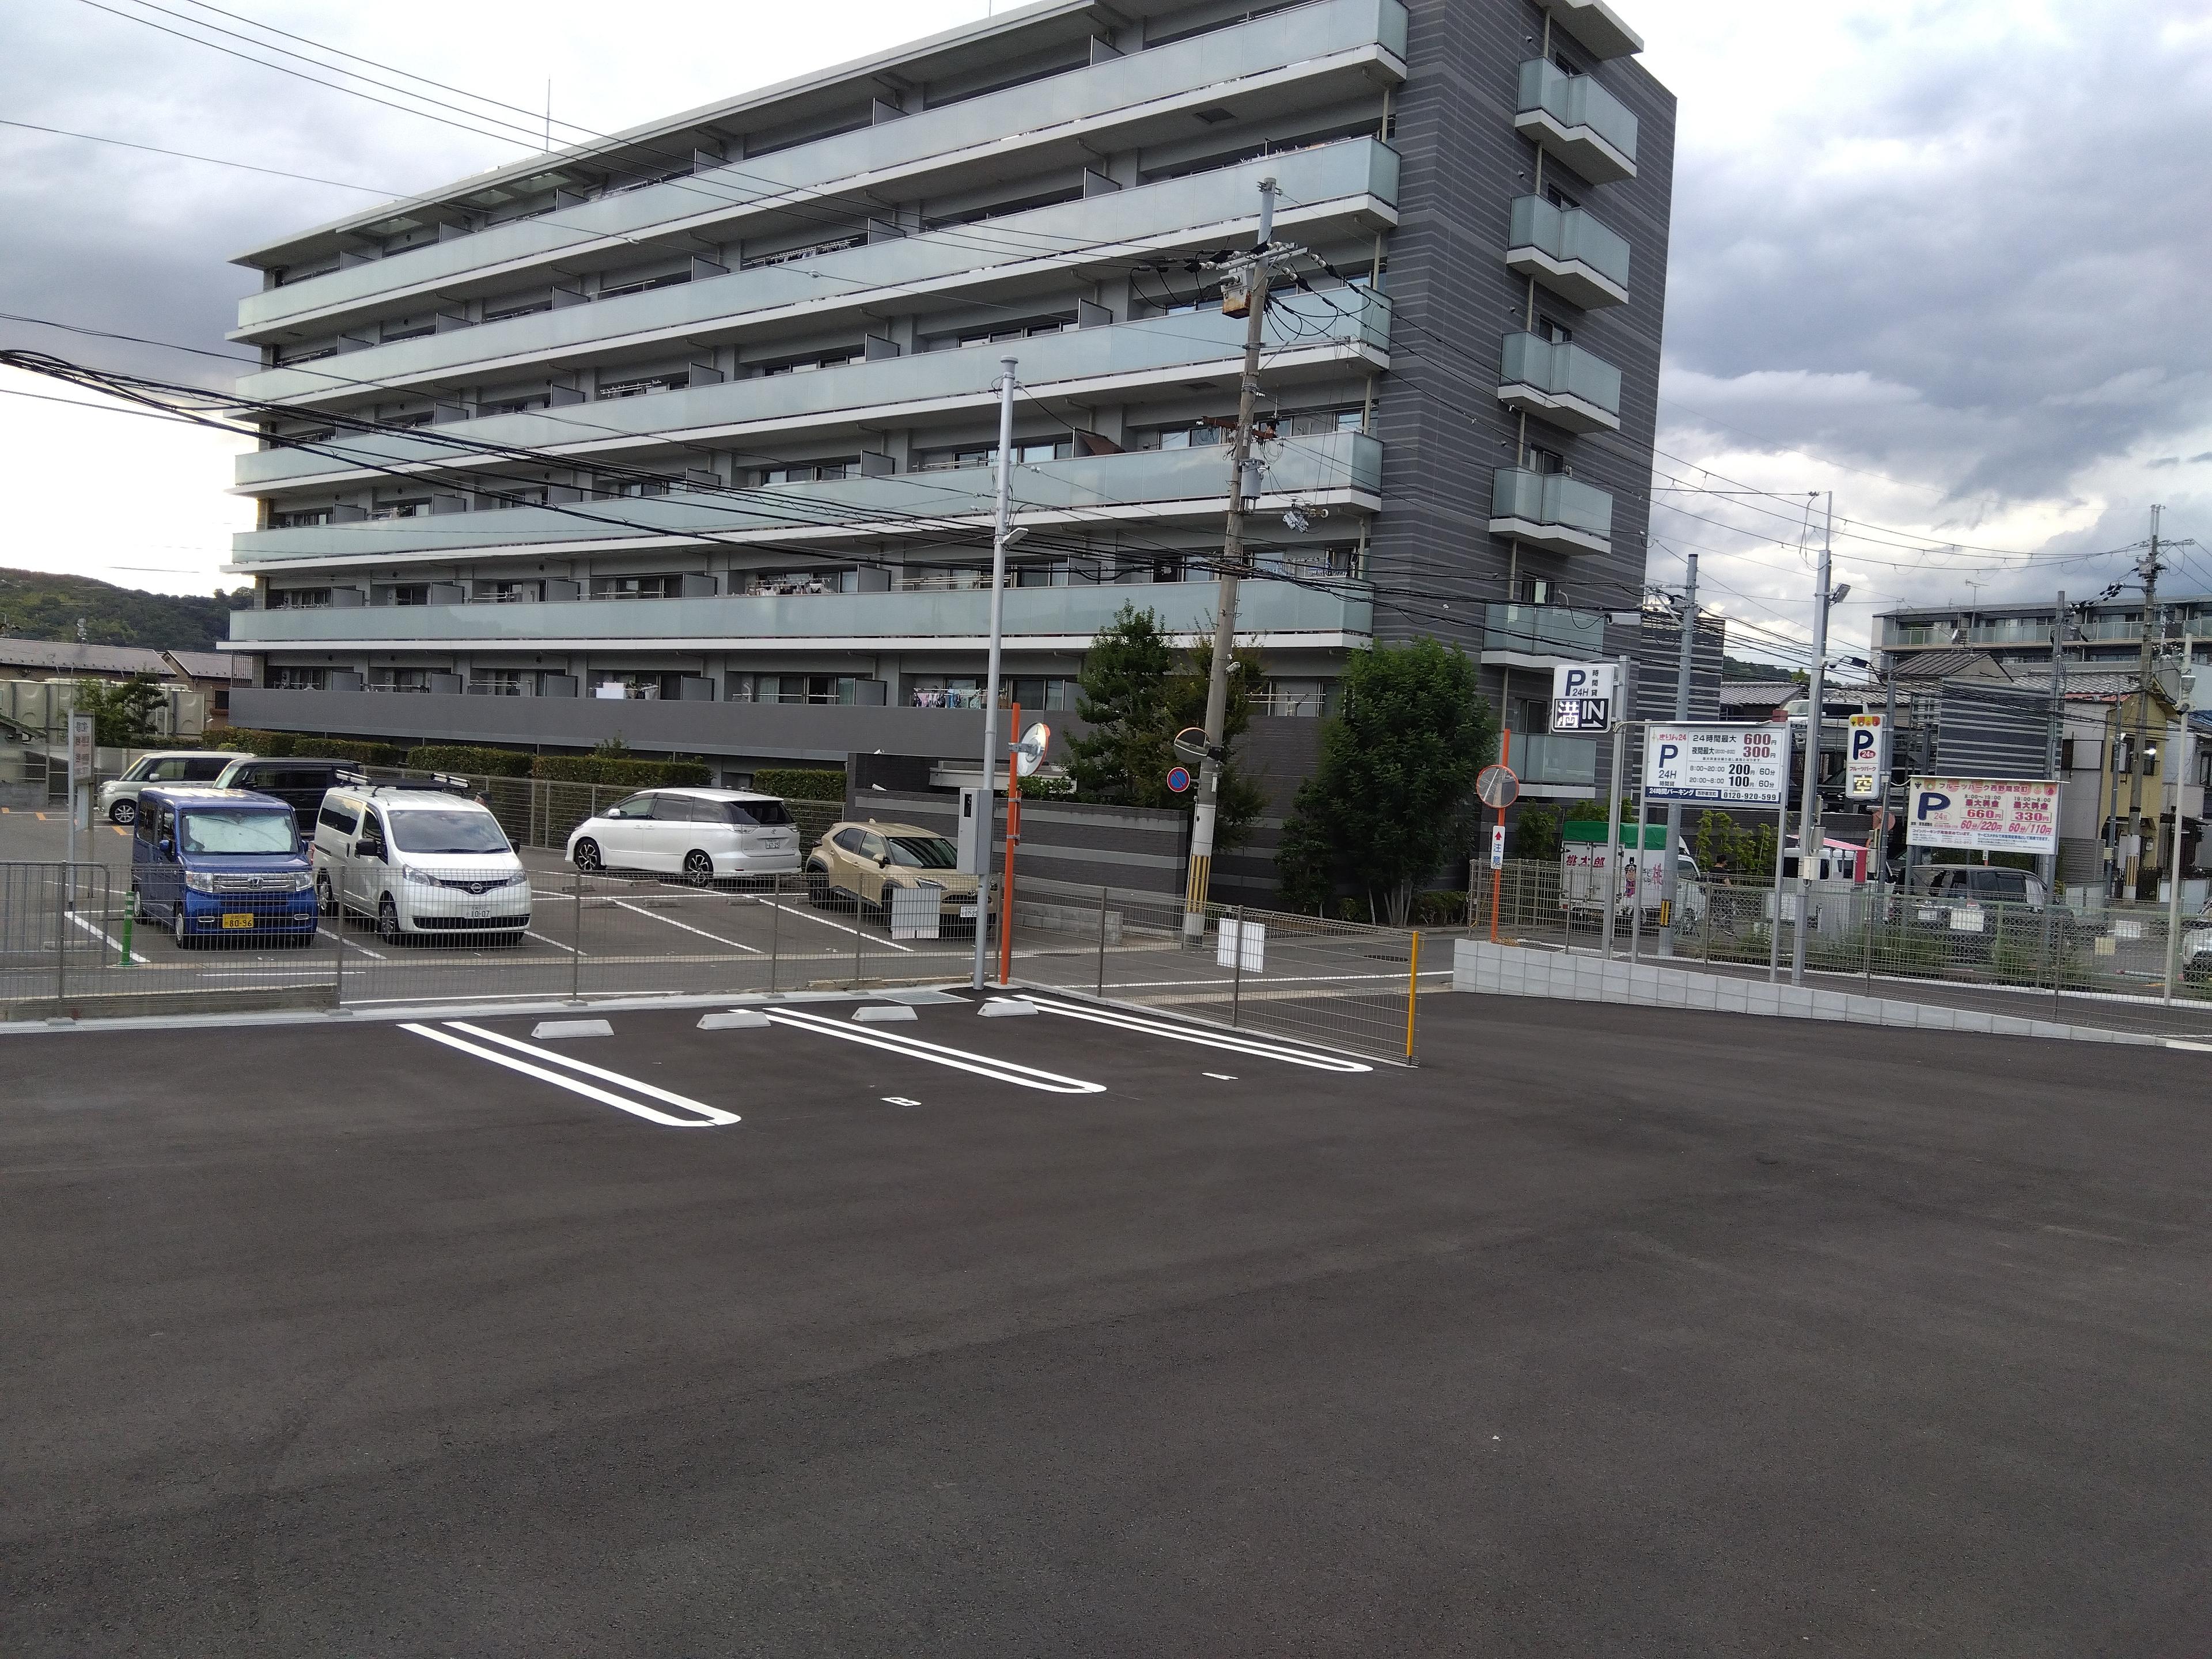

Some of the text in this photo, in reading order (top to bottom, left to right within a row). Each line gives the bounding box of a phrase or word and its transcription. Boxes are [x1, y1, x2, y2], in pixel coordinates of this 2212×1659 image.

[1565, 670, 1586, 696] P
[1591, 669, 1599, 696] 時間貸
[1557, 701, 1579, 726] 満
[1582, 700, 1605, 719] IN
[1692, 733, 1777, 745] 24時間最大 600円
[1853, 730, 1874, 760] P
[1659, 744, 1679, 768] P
[1692, 747, 1715, 755] 夜間最大
[1743, 746, 1776, 758] 300円
[1658, 770, 1677, 779] 24H
[1728, 764, 1755, 775] 200円
[1759, 768, 1775, 776] 60分
[1729, 776, 1754, 787] 100円
[1759, 780, 1774, 788] 60分
[1853, 775, 1872, 794] 空
[1649, 787, 1695, 796] 24時間パーキング
[1724, 792, 1777, 800] 0120-920-599
[1917, 792, 1951, 821] P
[1965, 799, 1999, 808] 最大料金
[2013, 801, 2048, 810] 最大料金
[1967, 809, 2001, 819] 660円
[2015, 812, 2049, 821] 330円
[1493, 843, 1501, 866] 注意
